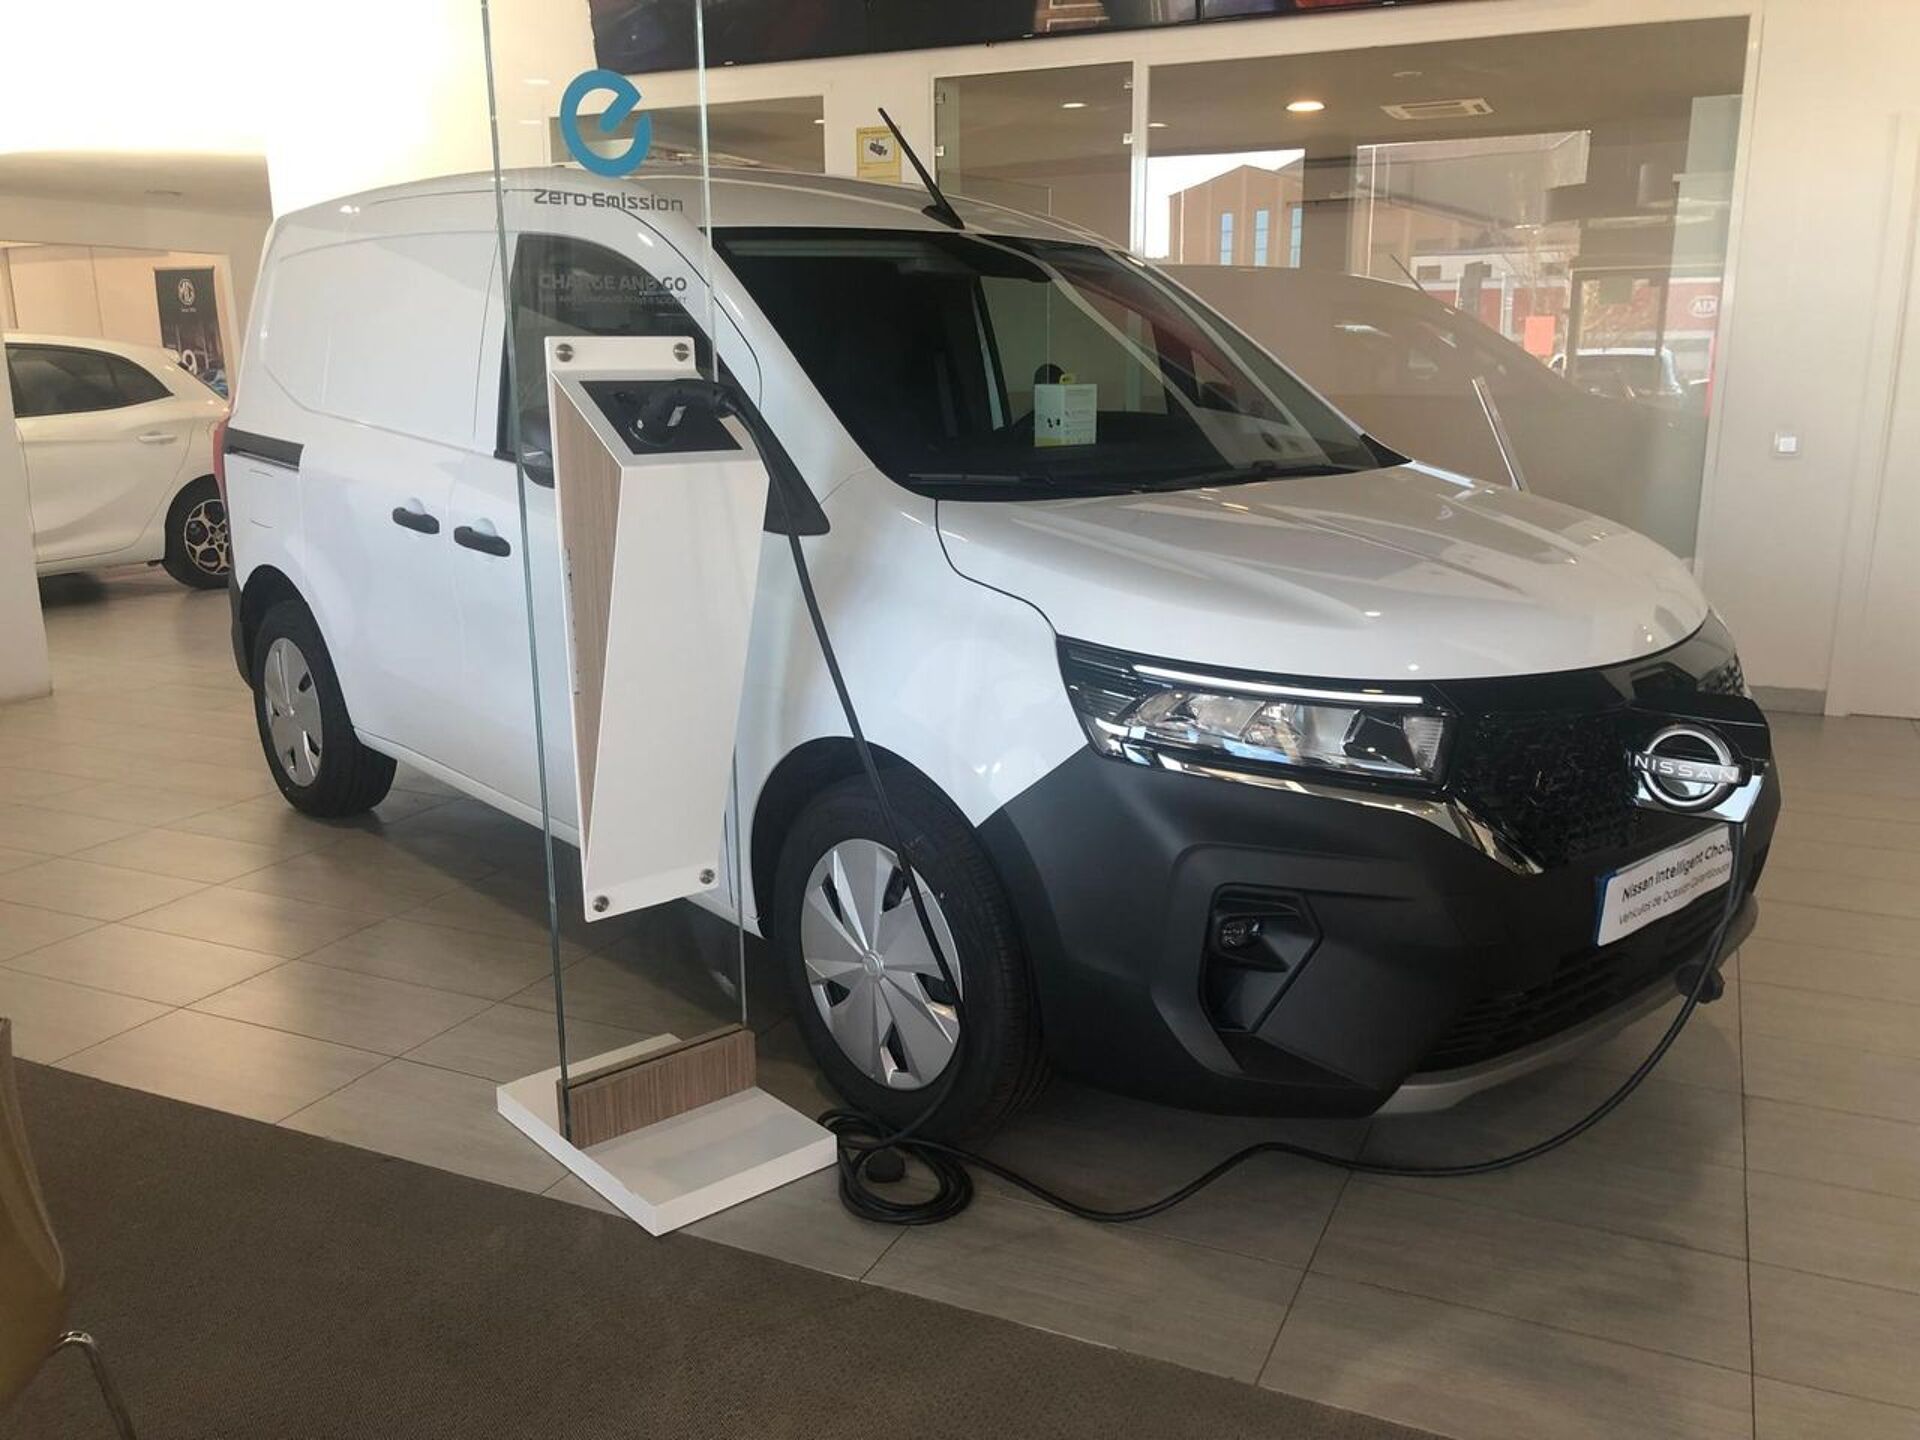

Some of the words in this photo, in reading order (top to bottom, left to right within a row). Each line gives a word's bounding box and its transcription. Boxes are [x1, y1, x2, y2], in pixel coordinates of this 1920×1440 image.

[534, 189, 588, 206] Zero
[591, 192, 683, 212] Emission
[662, 276, 687, 291] GO
[1634, 754, 1738, 781] NISSAN
[1621, 875, 1654, 902] Nissan
[1655, 851, 1704, 885] Intelligent
[1704, 838, 1732, 860] Choi
